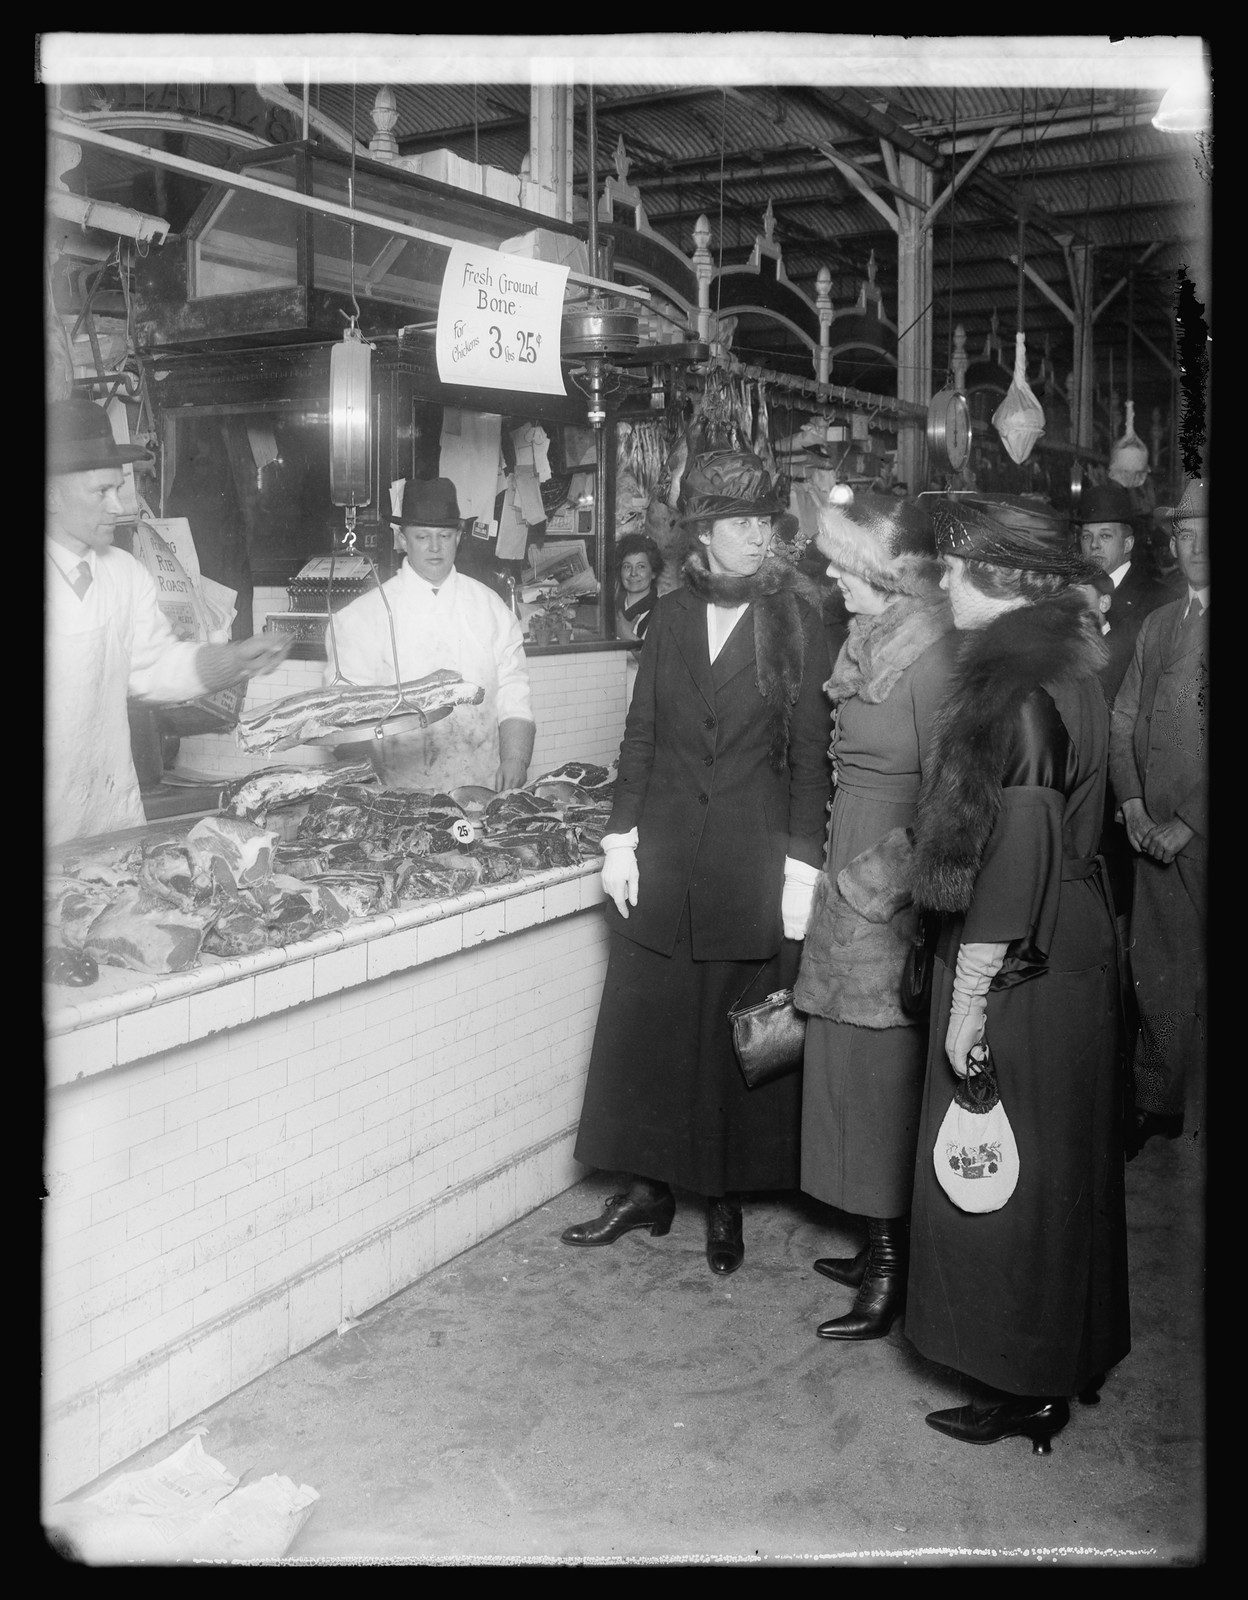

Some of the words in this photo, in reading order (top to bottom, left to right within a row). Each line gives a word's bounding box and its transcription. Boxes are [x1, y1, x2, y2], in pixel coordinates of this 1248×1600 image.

[462, 263, 493, 288] Fresh
[498, 274, 538, 296] Ground
[476, 289, 517, 316] Bone
[451, 337, 480, 363] Chickens
[488, 325, 503, 359] 3
[157, 575, 188, 594] ROAST
